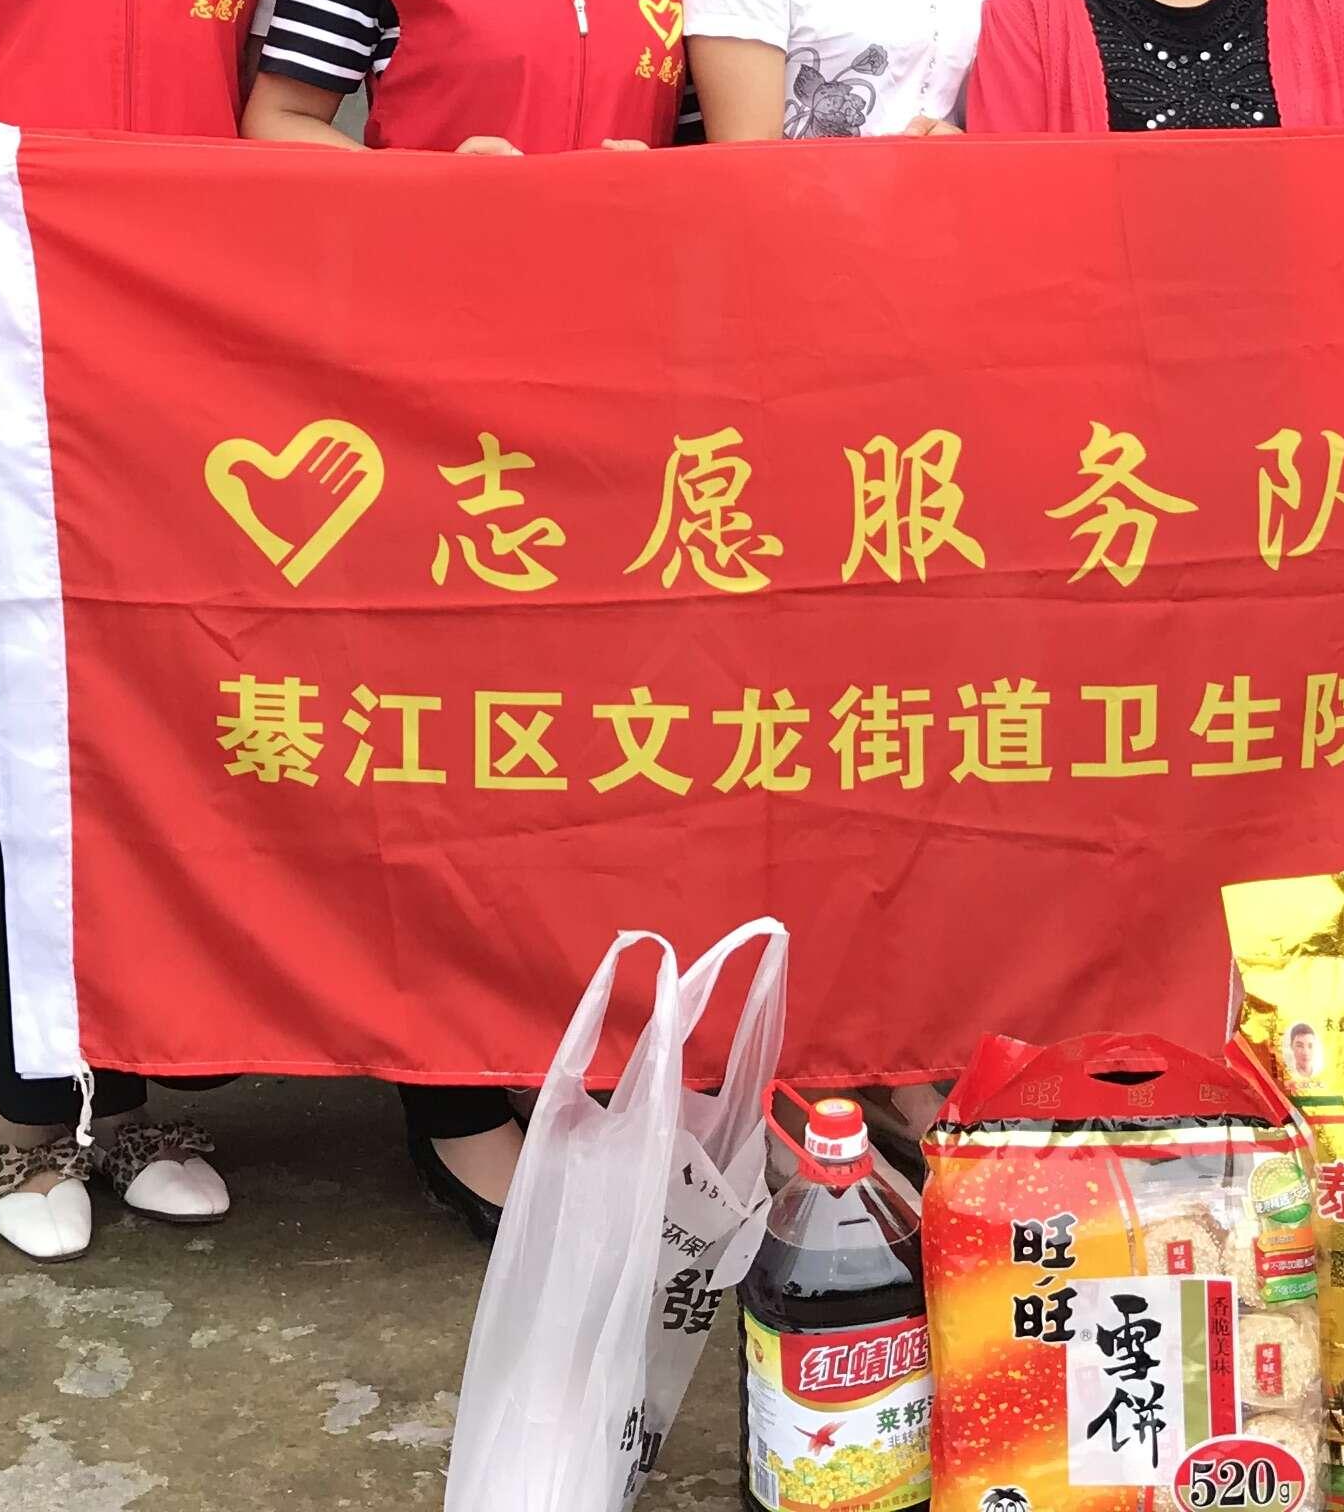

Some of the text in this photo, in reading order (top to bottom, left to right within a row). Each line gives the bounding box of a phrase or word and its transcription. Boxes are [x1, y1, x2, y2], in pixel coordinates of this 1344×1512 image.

[662, 1216, 716, 1258] 环保
[1012, 1212, 1078, 1343] 旺旺
[798, 1326, 929, 1391] 红蜻蜓
[1086, 1294, 1167, 1469] 雪饼
[1190, 1459, 1291, 1507] 520g
